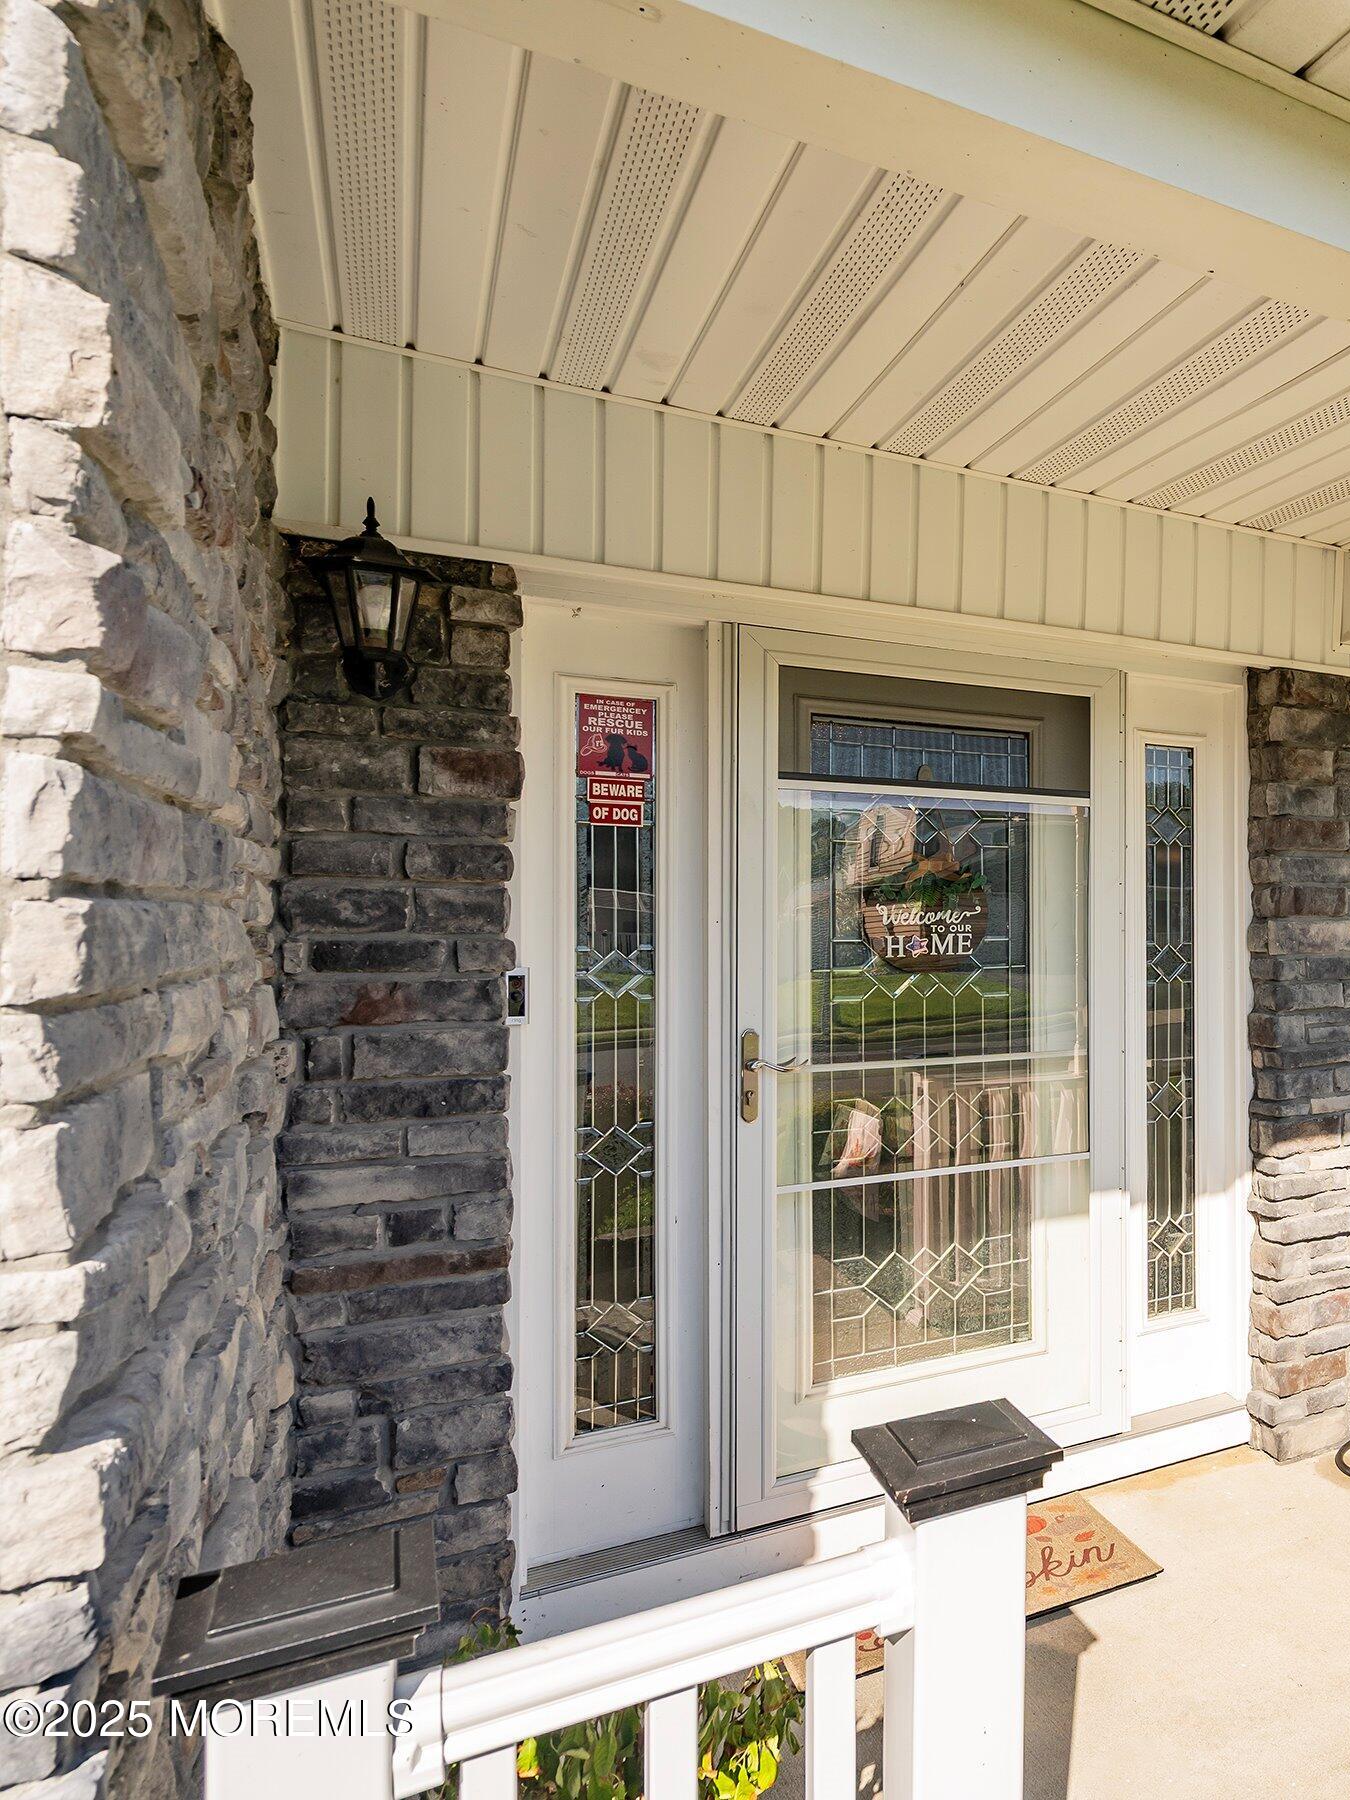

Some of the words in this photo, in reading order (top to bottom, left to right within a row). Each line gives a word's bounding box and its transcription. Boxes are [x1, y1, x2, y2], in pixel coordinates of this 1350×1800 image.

[584, 704, 648, 715] EMERGENCEY
[598, 712, 634, 720] PLEASE
[588, 717, 643, 729] RESCUE
[626, 729, 649, 737] KIDS
[592, 783, 643, 798] BEWARE
[592, 807, 609, 819] OF
[612, 808, 639, 821] DOG
[876, 903, 981, 926] Welcome
[930, 925, 945, 933] TO
[950, 924, 972, 933] OUR
